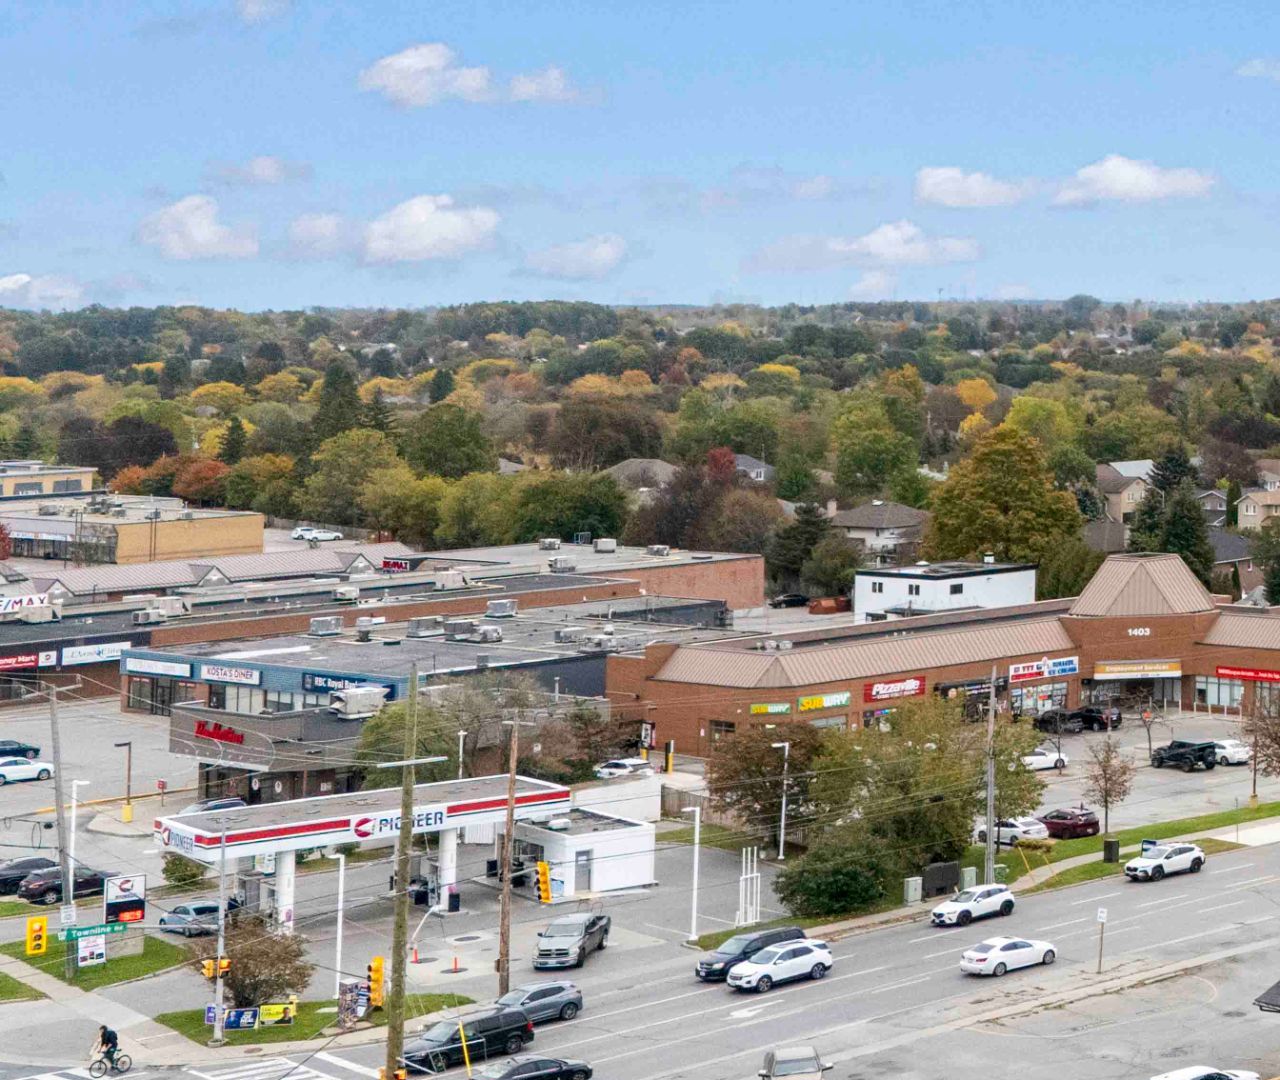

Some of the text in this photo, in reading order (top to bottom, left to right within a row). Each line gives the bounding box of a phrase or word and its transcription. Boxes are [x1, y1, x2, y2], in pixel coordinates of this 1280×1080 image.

[1127, 627, 1150, 636] 1403
[314, 676, 327, 688] RBC
[800, 692, 850, 711] SUBWAY
[752, 704, 789, 714] SUBWAY
[71, 926, 112, 938] Townline
